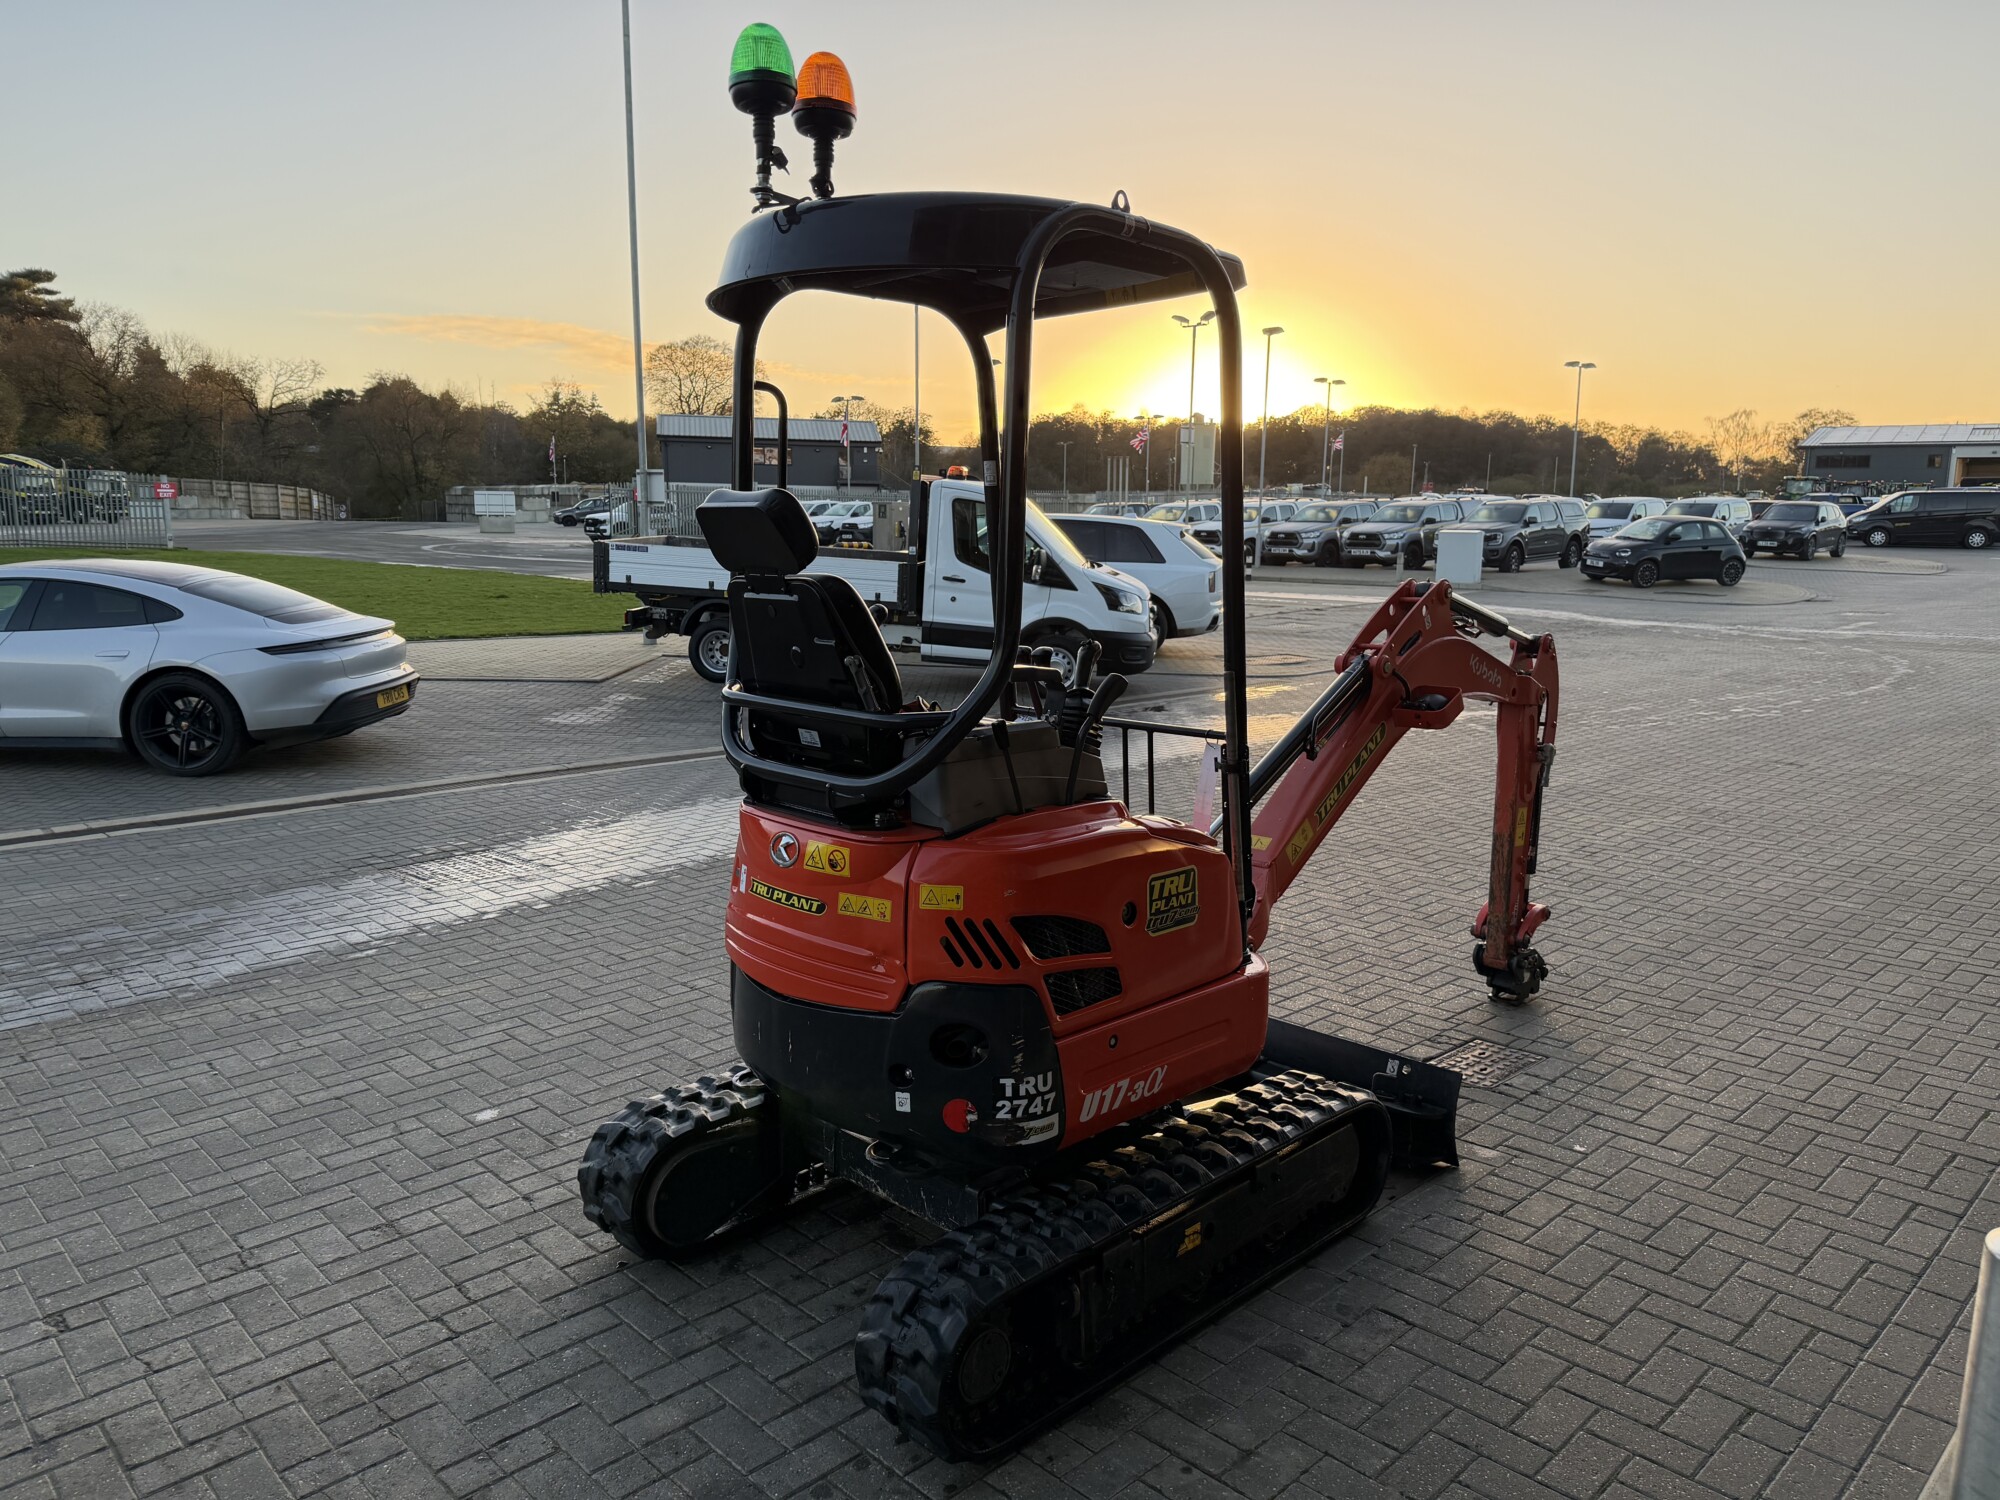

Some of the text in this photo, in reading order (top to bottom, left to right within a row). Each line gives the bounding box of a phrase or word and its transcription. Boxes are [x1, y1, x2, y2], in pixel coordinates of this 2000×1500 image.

[1470, 653, 1502, 688] Kubota
[1318, 729, 1382, 819] TRU PLANT
[752, 881, 821, 912] TRU PLANT
[1151, 871, 1194, 900] TRU
[1151, 892, 1194, 914] PLANT
[999, 1071, 1053, 1097] TRU
[995, 1091, 1056, 1119] 2747
